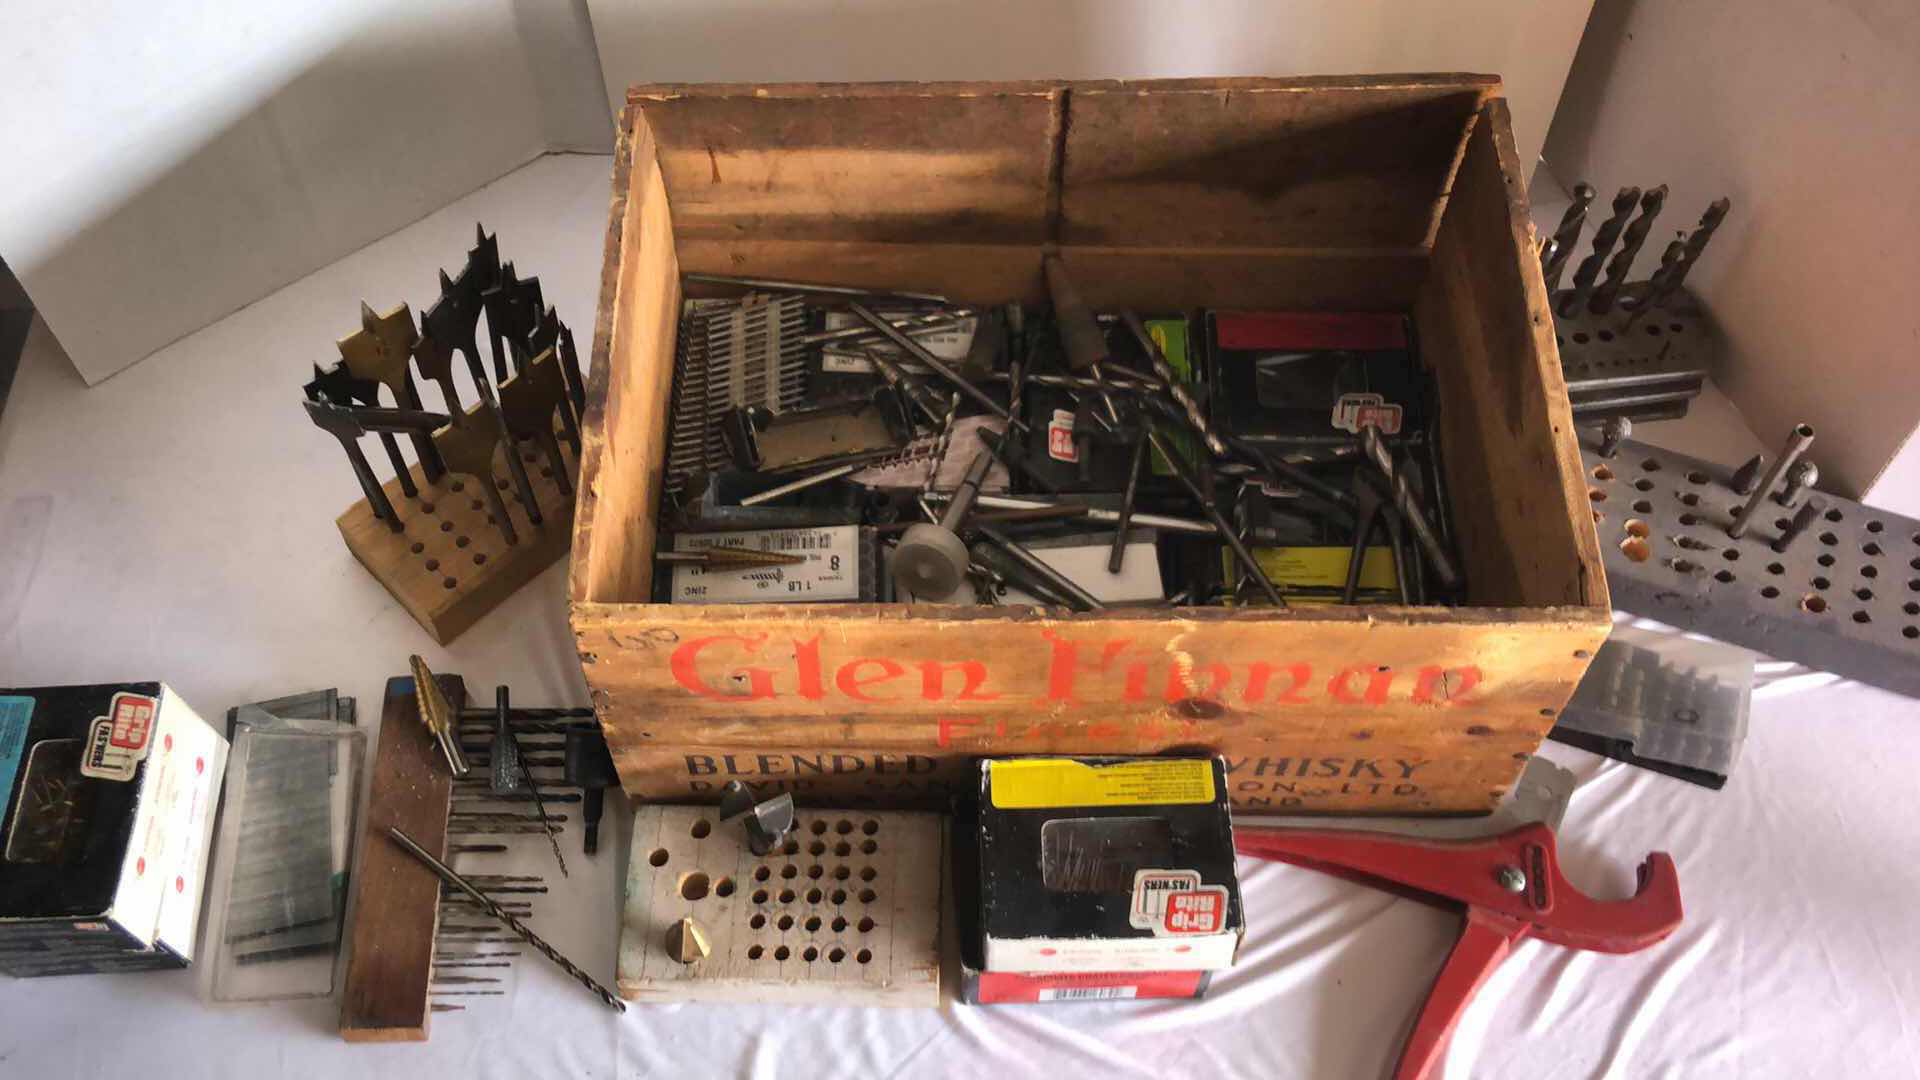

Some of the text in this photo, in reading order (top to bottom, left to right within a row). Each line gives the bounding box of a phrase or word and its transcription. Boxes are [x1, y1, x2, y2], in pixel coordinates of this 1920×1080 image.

[830, 554, 841, 571] 8
[788, 581, 802, 592] LB
[670, 631, 1004, 701] Glen
[129, 705, 150, 744] Grip
[685, 754, 937, 775] BLENDED
[1171, 912, 1215, 930] Grip
